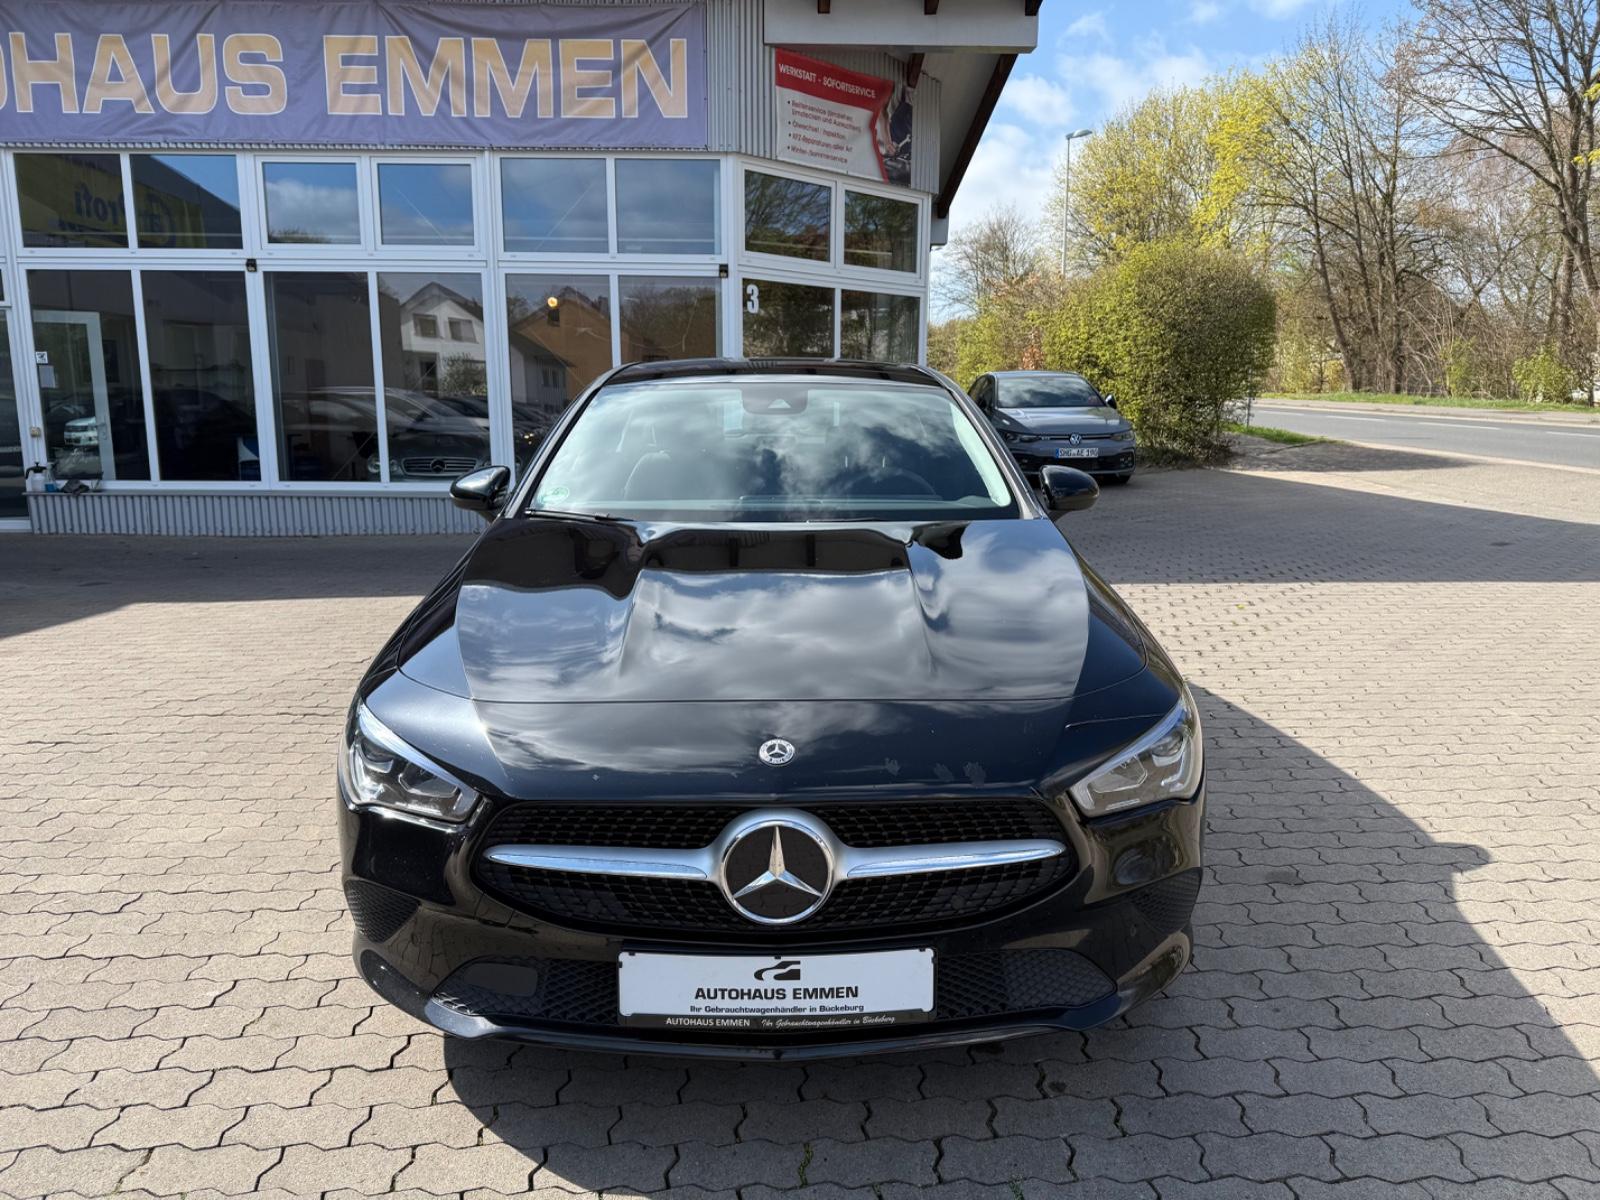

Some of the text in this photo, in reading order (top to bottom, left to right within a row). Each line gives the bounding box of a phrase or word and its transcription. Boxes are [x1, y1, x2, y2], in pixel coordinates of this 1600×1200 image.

[0, 32, 688, 118] HAUS EMMEN
[778, 63, 817, 83] WERKSTATT
[823, 75, 876, 98] SOFORTSERVICE
[746, 283, 760, 314] 3
[694, 986, 859, 1001] AUTOHAUS EMMEN
[690, 1004, 864, 1015] Ihr Gebrauchtwagenhändler in Bückeburg
[666, 1017, 750, 1027] AUTOHAUS EMMEN
